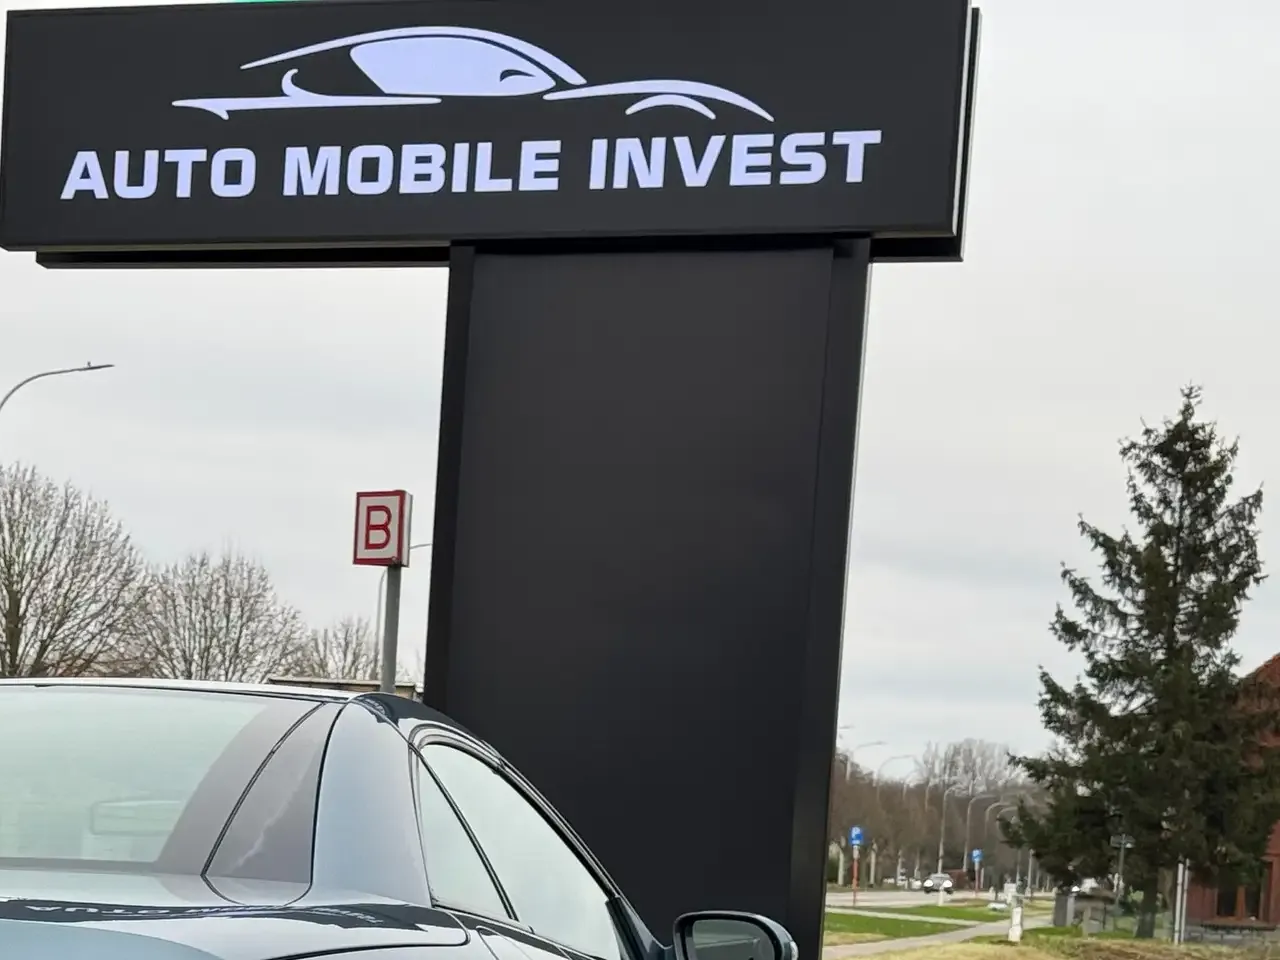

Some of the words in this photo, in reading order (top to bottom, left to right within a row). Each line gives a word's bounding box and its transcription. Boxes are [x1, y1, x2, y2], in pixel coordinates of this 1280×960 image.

[60, 147, 257, 201] AUTO
[282, 140, 563, 197] MOBILE
[588, 129, 883, 191] INVEST
[365, 505, 392, 550] B
